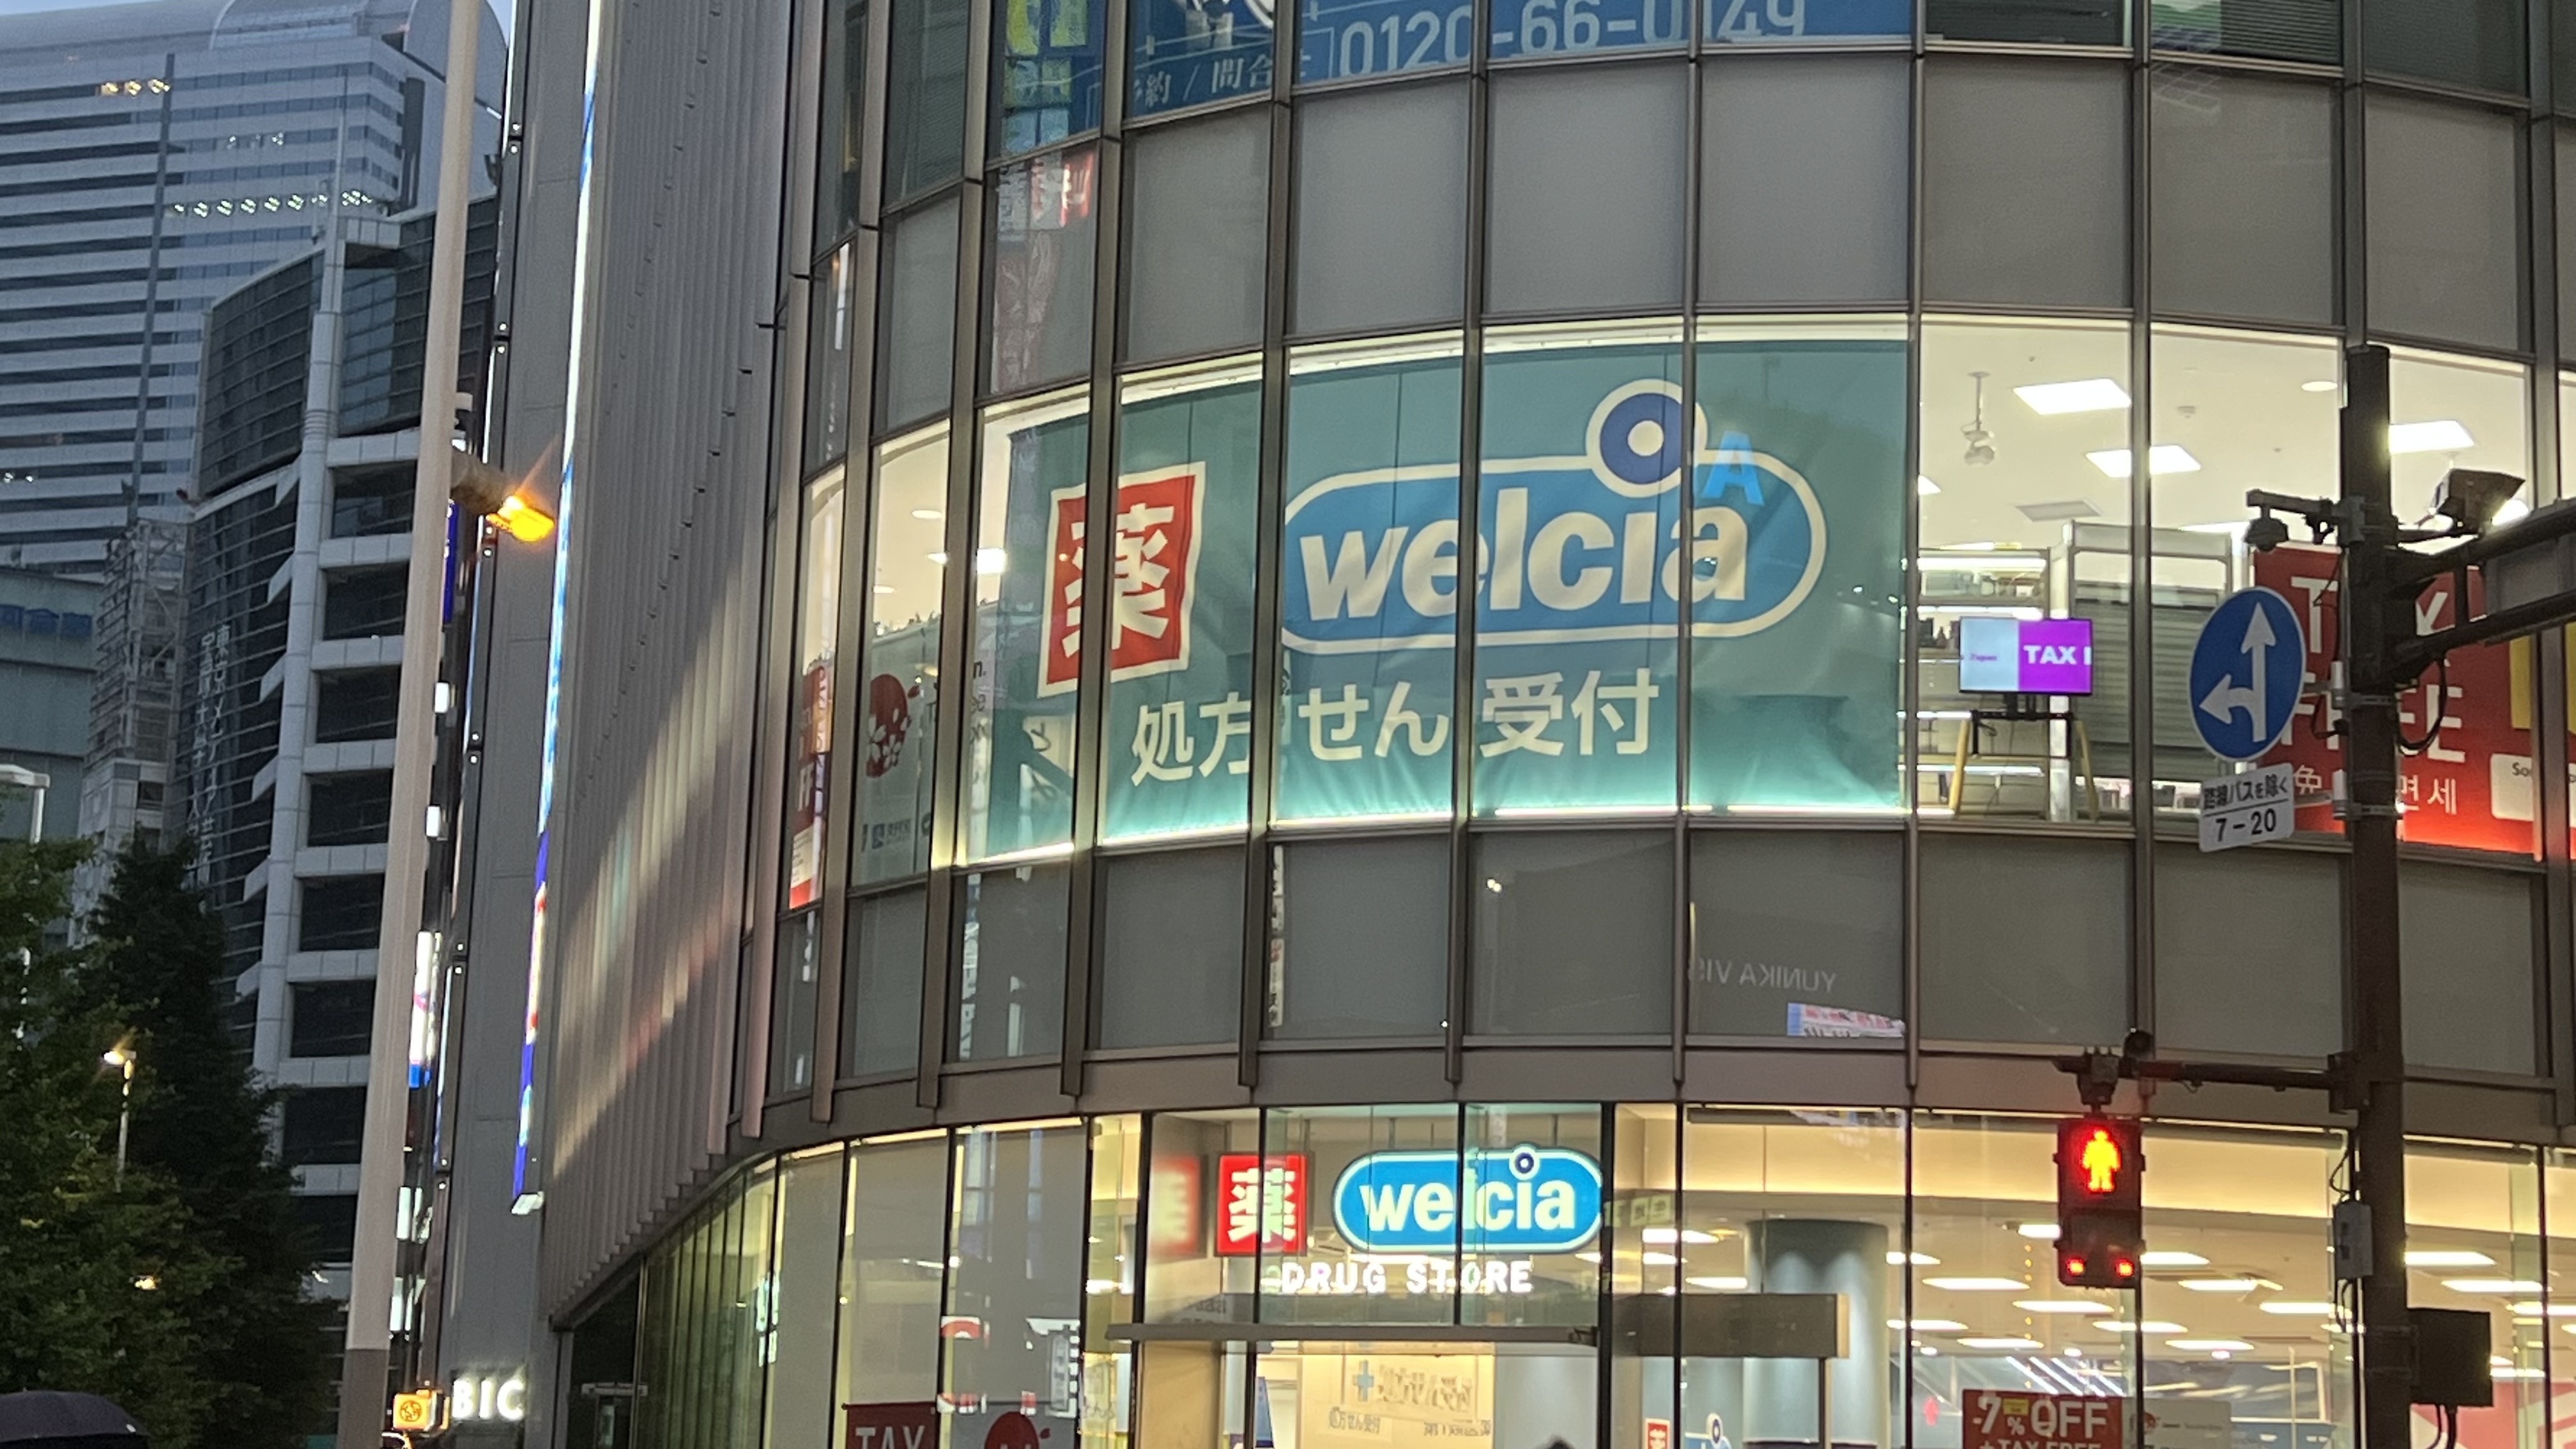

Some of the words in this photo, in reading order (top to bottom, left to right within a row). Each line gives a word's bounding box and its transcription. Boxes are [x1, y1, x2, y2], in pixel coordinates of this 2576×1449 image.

[1062, 503, 1174, 658] 薬
[1299, 487, 1748, 621] welcia
[2023, 645, 2077, 665] TAX
[1131, 668, 1659, 786] 処方せん受付
[2216, 808, 2276, 842] 7-20
[1227, 1167, 1296, 1243] 薬
[1358, 1167, 1576, 1232] welcia
[1281, 1261, 1387, 1294] DRUG
[1406, 1261, 1533, 1294] STORE
[451, 1379, 525, 1421] BIC
[2030, 1399, 2109, 1439] OFF
